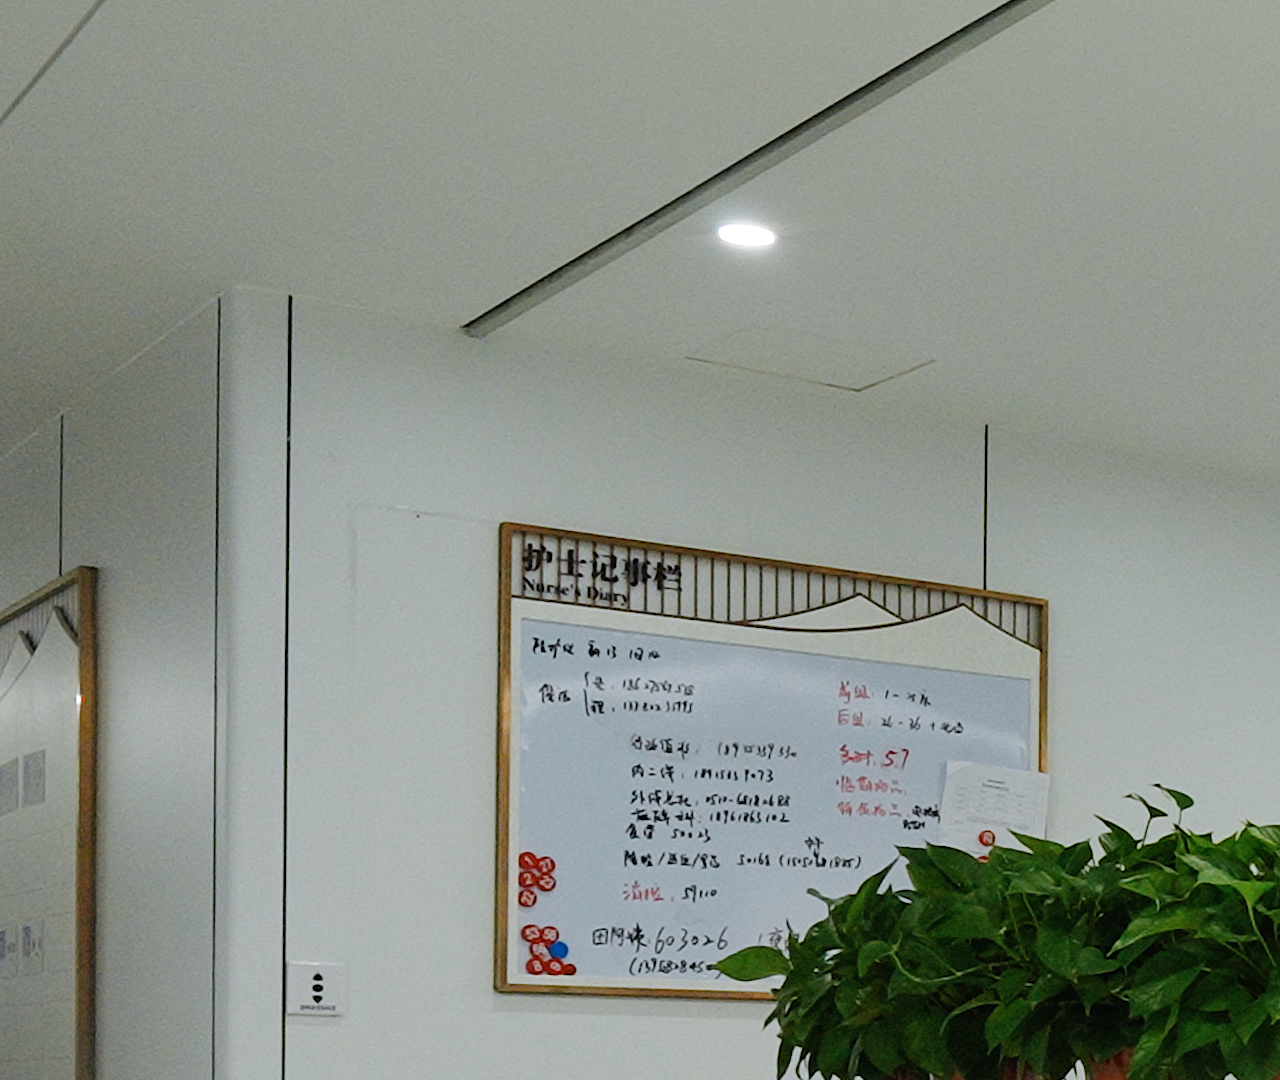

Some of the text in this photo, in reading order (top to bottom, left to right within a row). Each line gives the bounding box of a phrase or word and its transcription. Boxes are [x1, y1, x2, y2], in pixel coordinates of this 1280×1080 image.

[521, 543, 683, 592] 护士记事栏
[522, 576, 628, 606] Nurse's Diary
